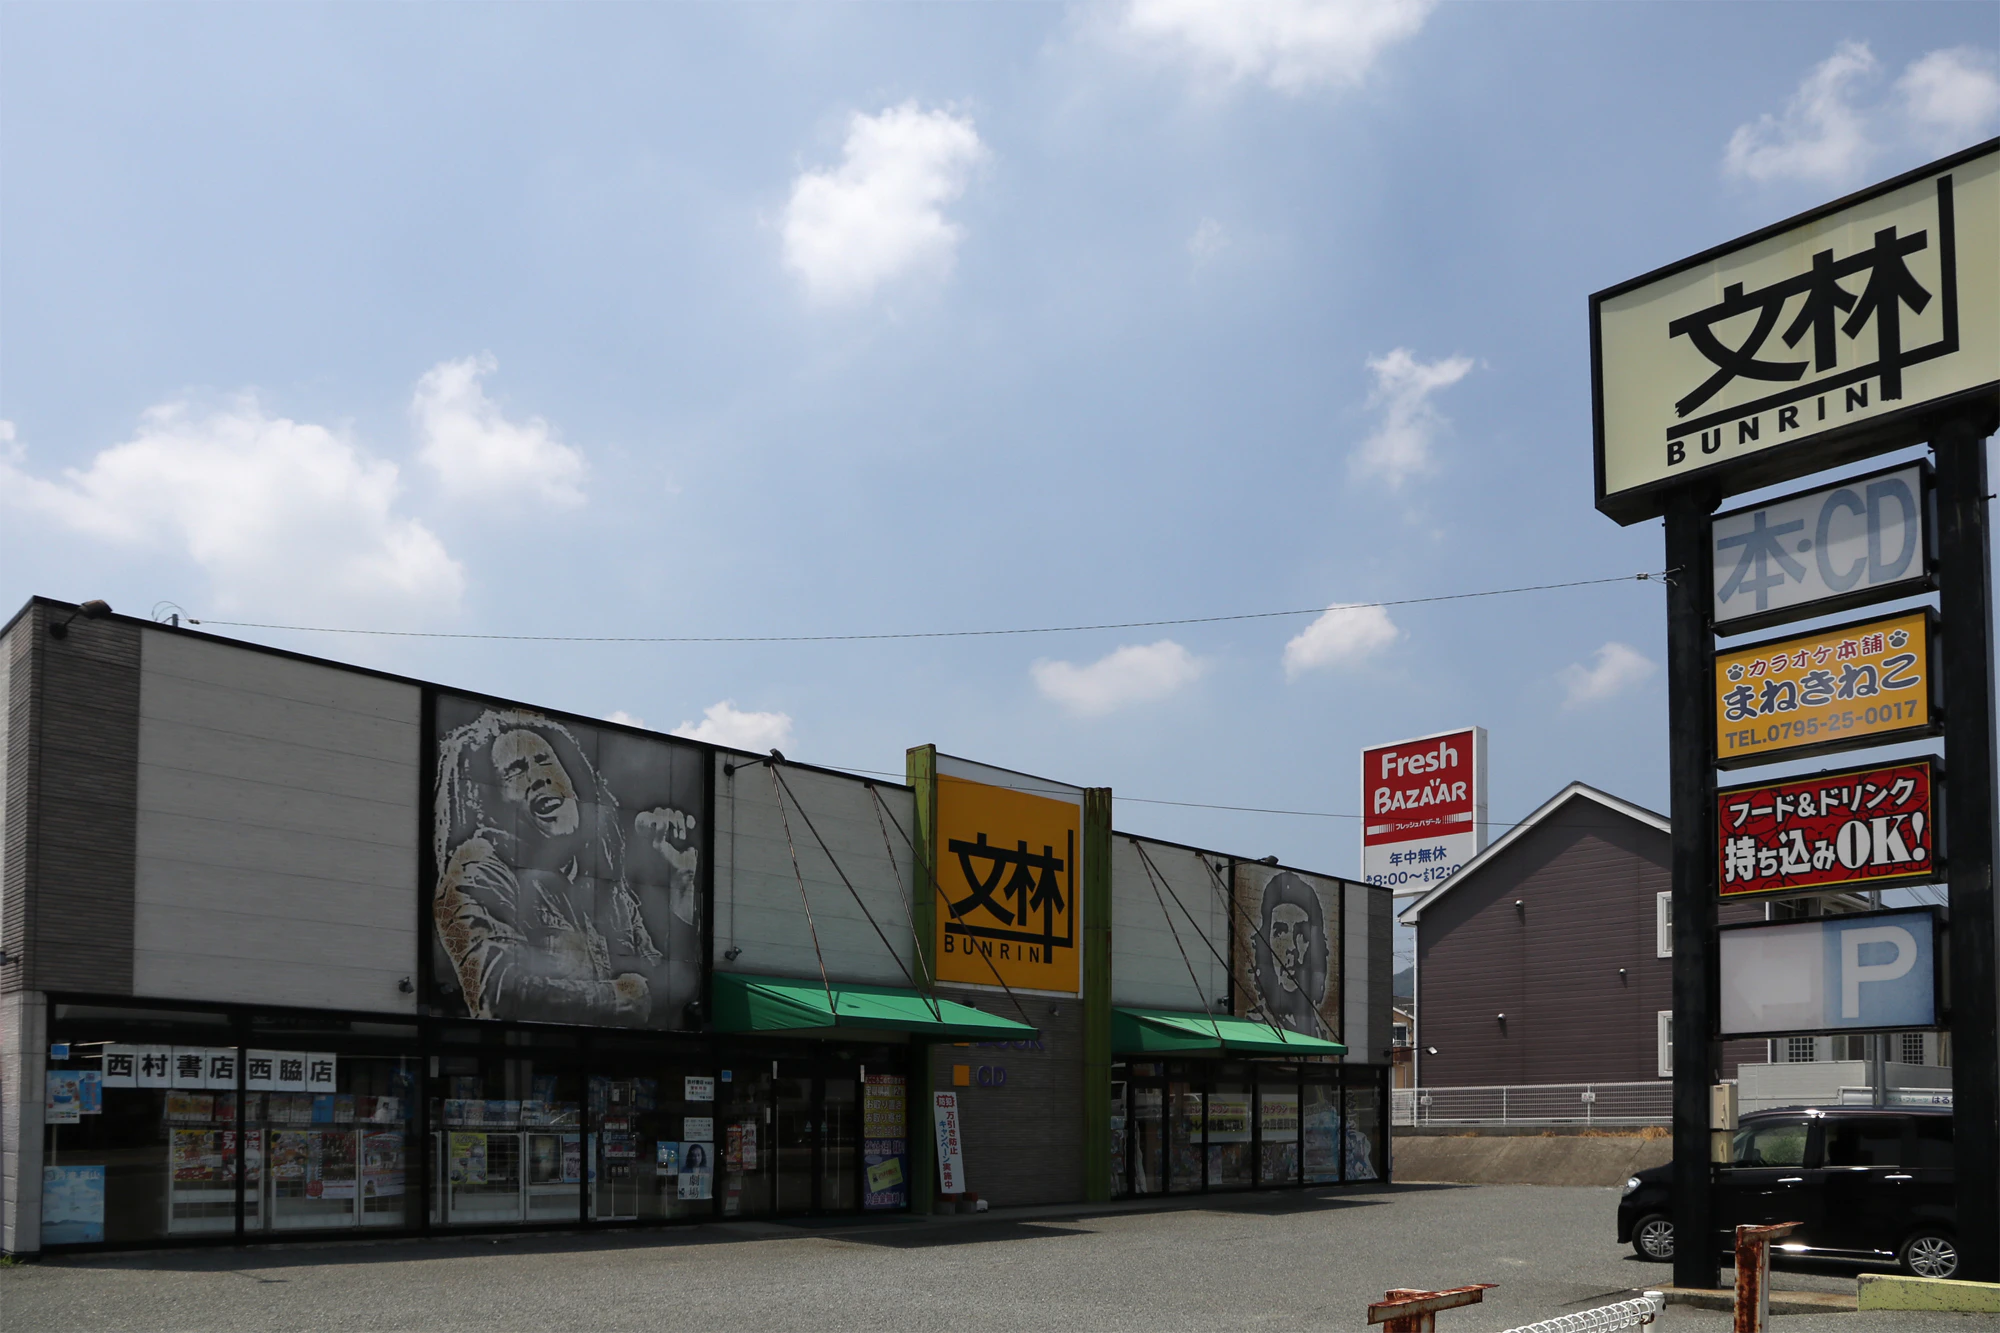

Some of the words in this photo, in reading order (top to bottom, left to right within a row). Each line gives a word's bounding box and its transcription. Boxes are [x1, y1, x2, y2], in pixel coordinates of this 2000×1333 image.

[1668, 224, 1933, 418] 文林
[1666, 382, 1869, 467] BUNRIN
[1747, 631, 1885, 678] カラオケ本舗
[1721, 652, 1921, 722] まねきねこ
[1725, 699, 1919, 751] TEL.0795-25-0017
[1381, 741, 1458, 780] Fresh
[1395, 817, 1442, 831] フレッシュバザール
[1729, 778, 1916, 829] フード&ドリンク
[1389, 845, 1447, 867] 年中無休
[1724, 811, 1927, 884] 持ち込みOK!
[947, 831, 1067, 958] 文林
[944, 934, 1040, 963] BUNRIN
[1840, 925, 1918, 1020] P
[106, 1053, 236, 1080] 西村書店
[248, 1057, 334, 1084] 西脇店
[976, 1065, 1008, 1088] CD
[1931, 1096, 1953, 1105] はる
[938, 1119, 954, 1190] キャンペーン実施中
[945, 1110, 959, 1156] 万引き防止
